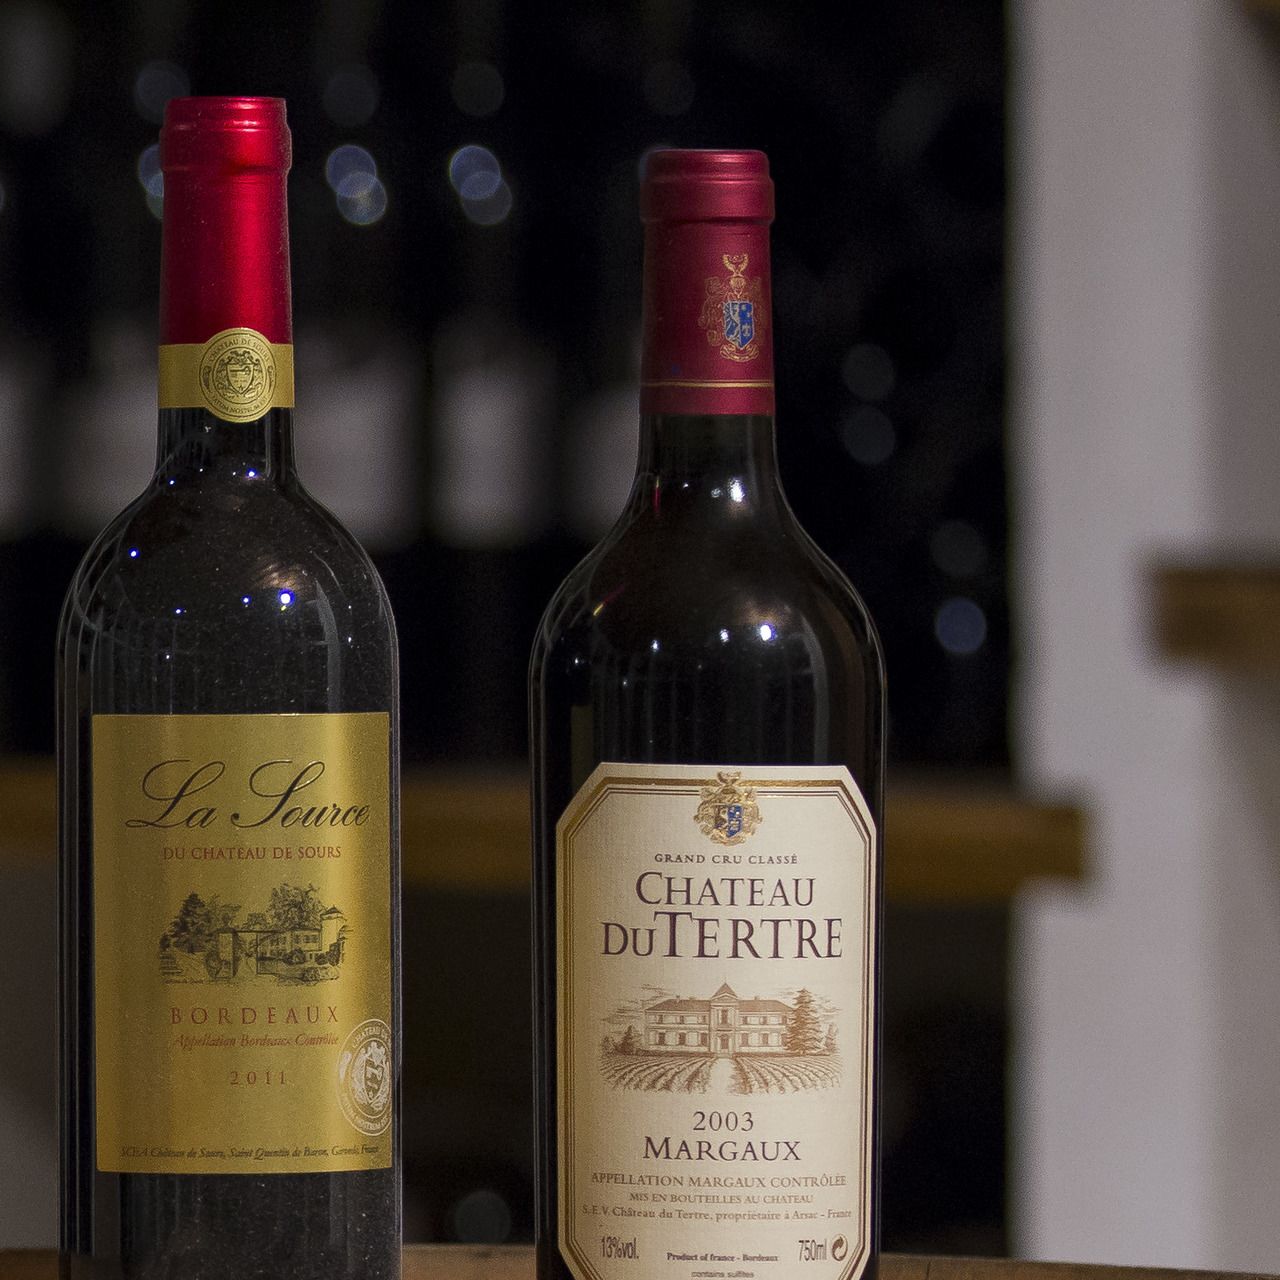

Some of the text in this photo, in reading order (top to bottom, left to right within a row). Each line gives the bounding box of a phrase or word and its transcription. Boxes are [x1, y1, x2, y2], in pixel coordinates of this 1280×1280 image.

[125, 759, 370, 828] La Source
[163, 846, 341, 860] DU CHATEAU DE SOURS
[654, 853, 798, 865] GRAND CRU CLASSÉ
[635, 871, 816, 907] CHATEAU
[601, 911, 842, 959] DU TERTRE
[170, 1006, 339, 1025] BORDEAUX
[230, 1071, 286, 1085] 2011
[693, 1111, 754, 1132] 2003
[642, 1136, 801, 1161] MARGAUX
[591, 1172, 684, 1187] APPELLATION
[688, 1176, 766, 1188] MARGAUX
[630, 1192, 814, 1204] MIS EN BOUTEILLES AU CHATEAU
[612, 1206, 656, 1218] Château
[658, 1208, 673, 1219] du
[667, 1252, 698, 1261] Product
[700, 1253, 709, 1261] of
[798, 1239, 827, 1261] 750ml
